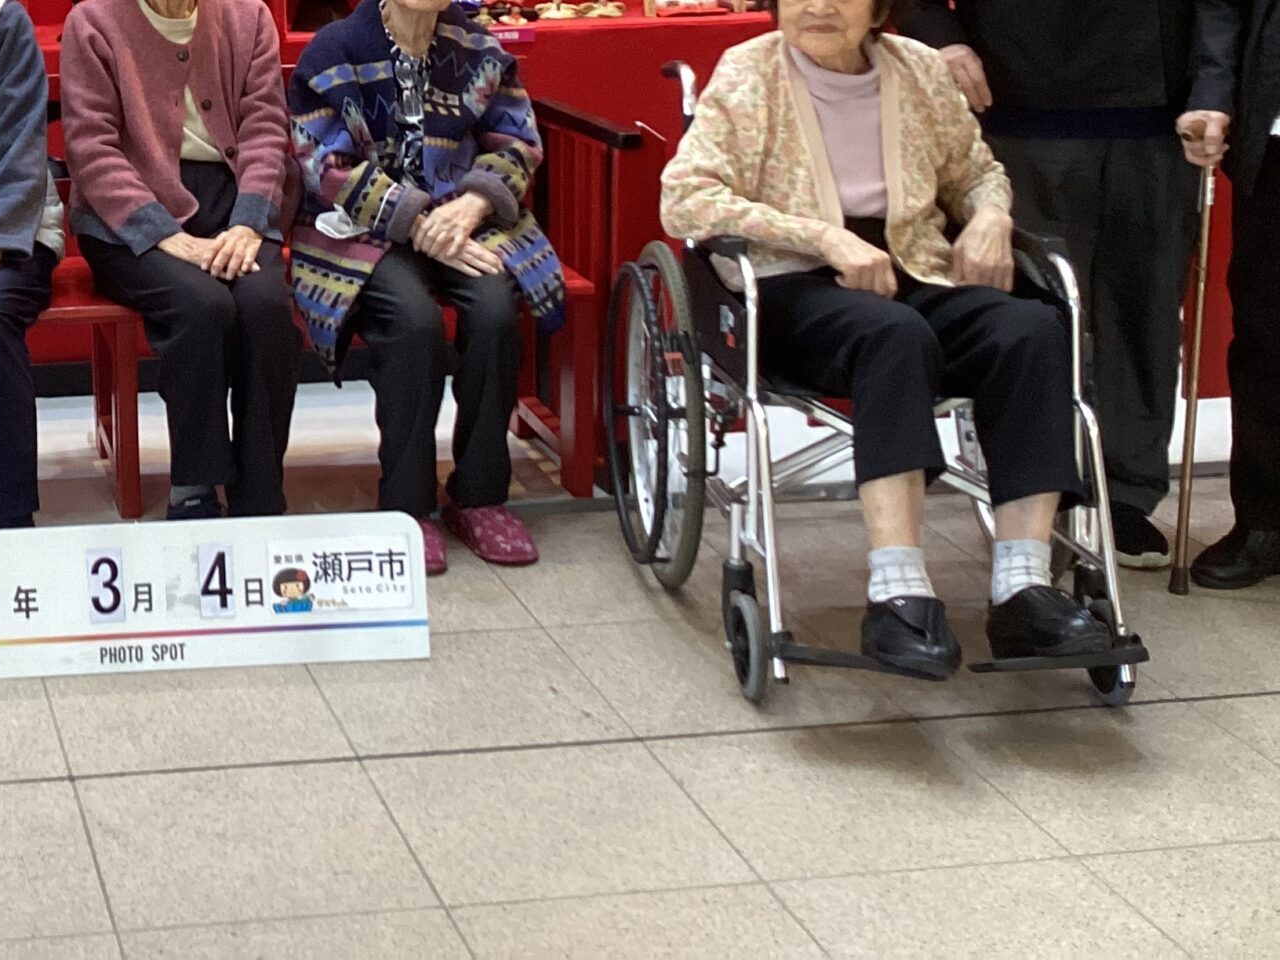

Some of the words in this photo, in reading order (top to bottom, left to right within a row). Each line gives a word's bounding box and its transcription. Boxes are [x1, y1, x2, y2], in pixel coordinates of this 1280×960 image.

[312, 549, 406, 584] 瀬戸市
[100, 645, 144, 664] PHOTO
[151, 643, 186, 662] SPOT
